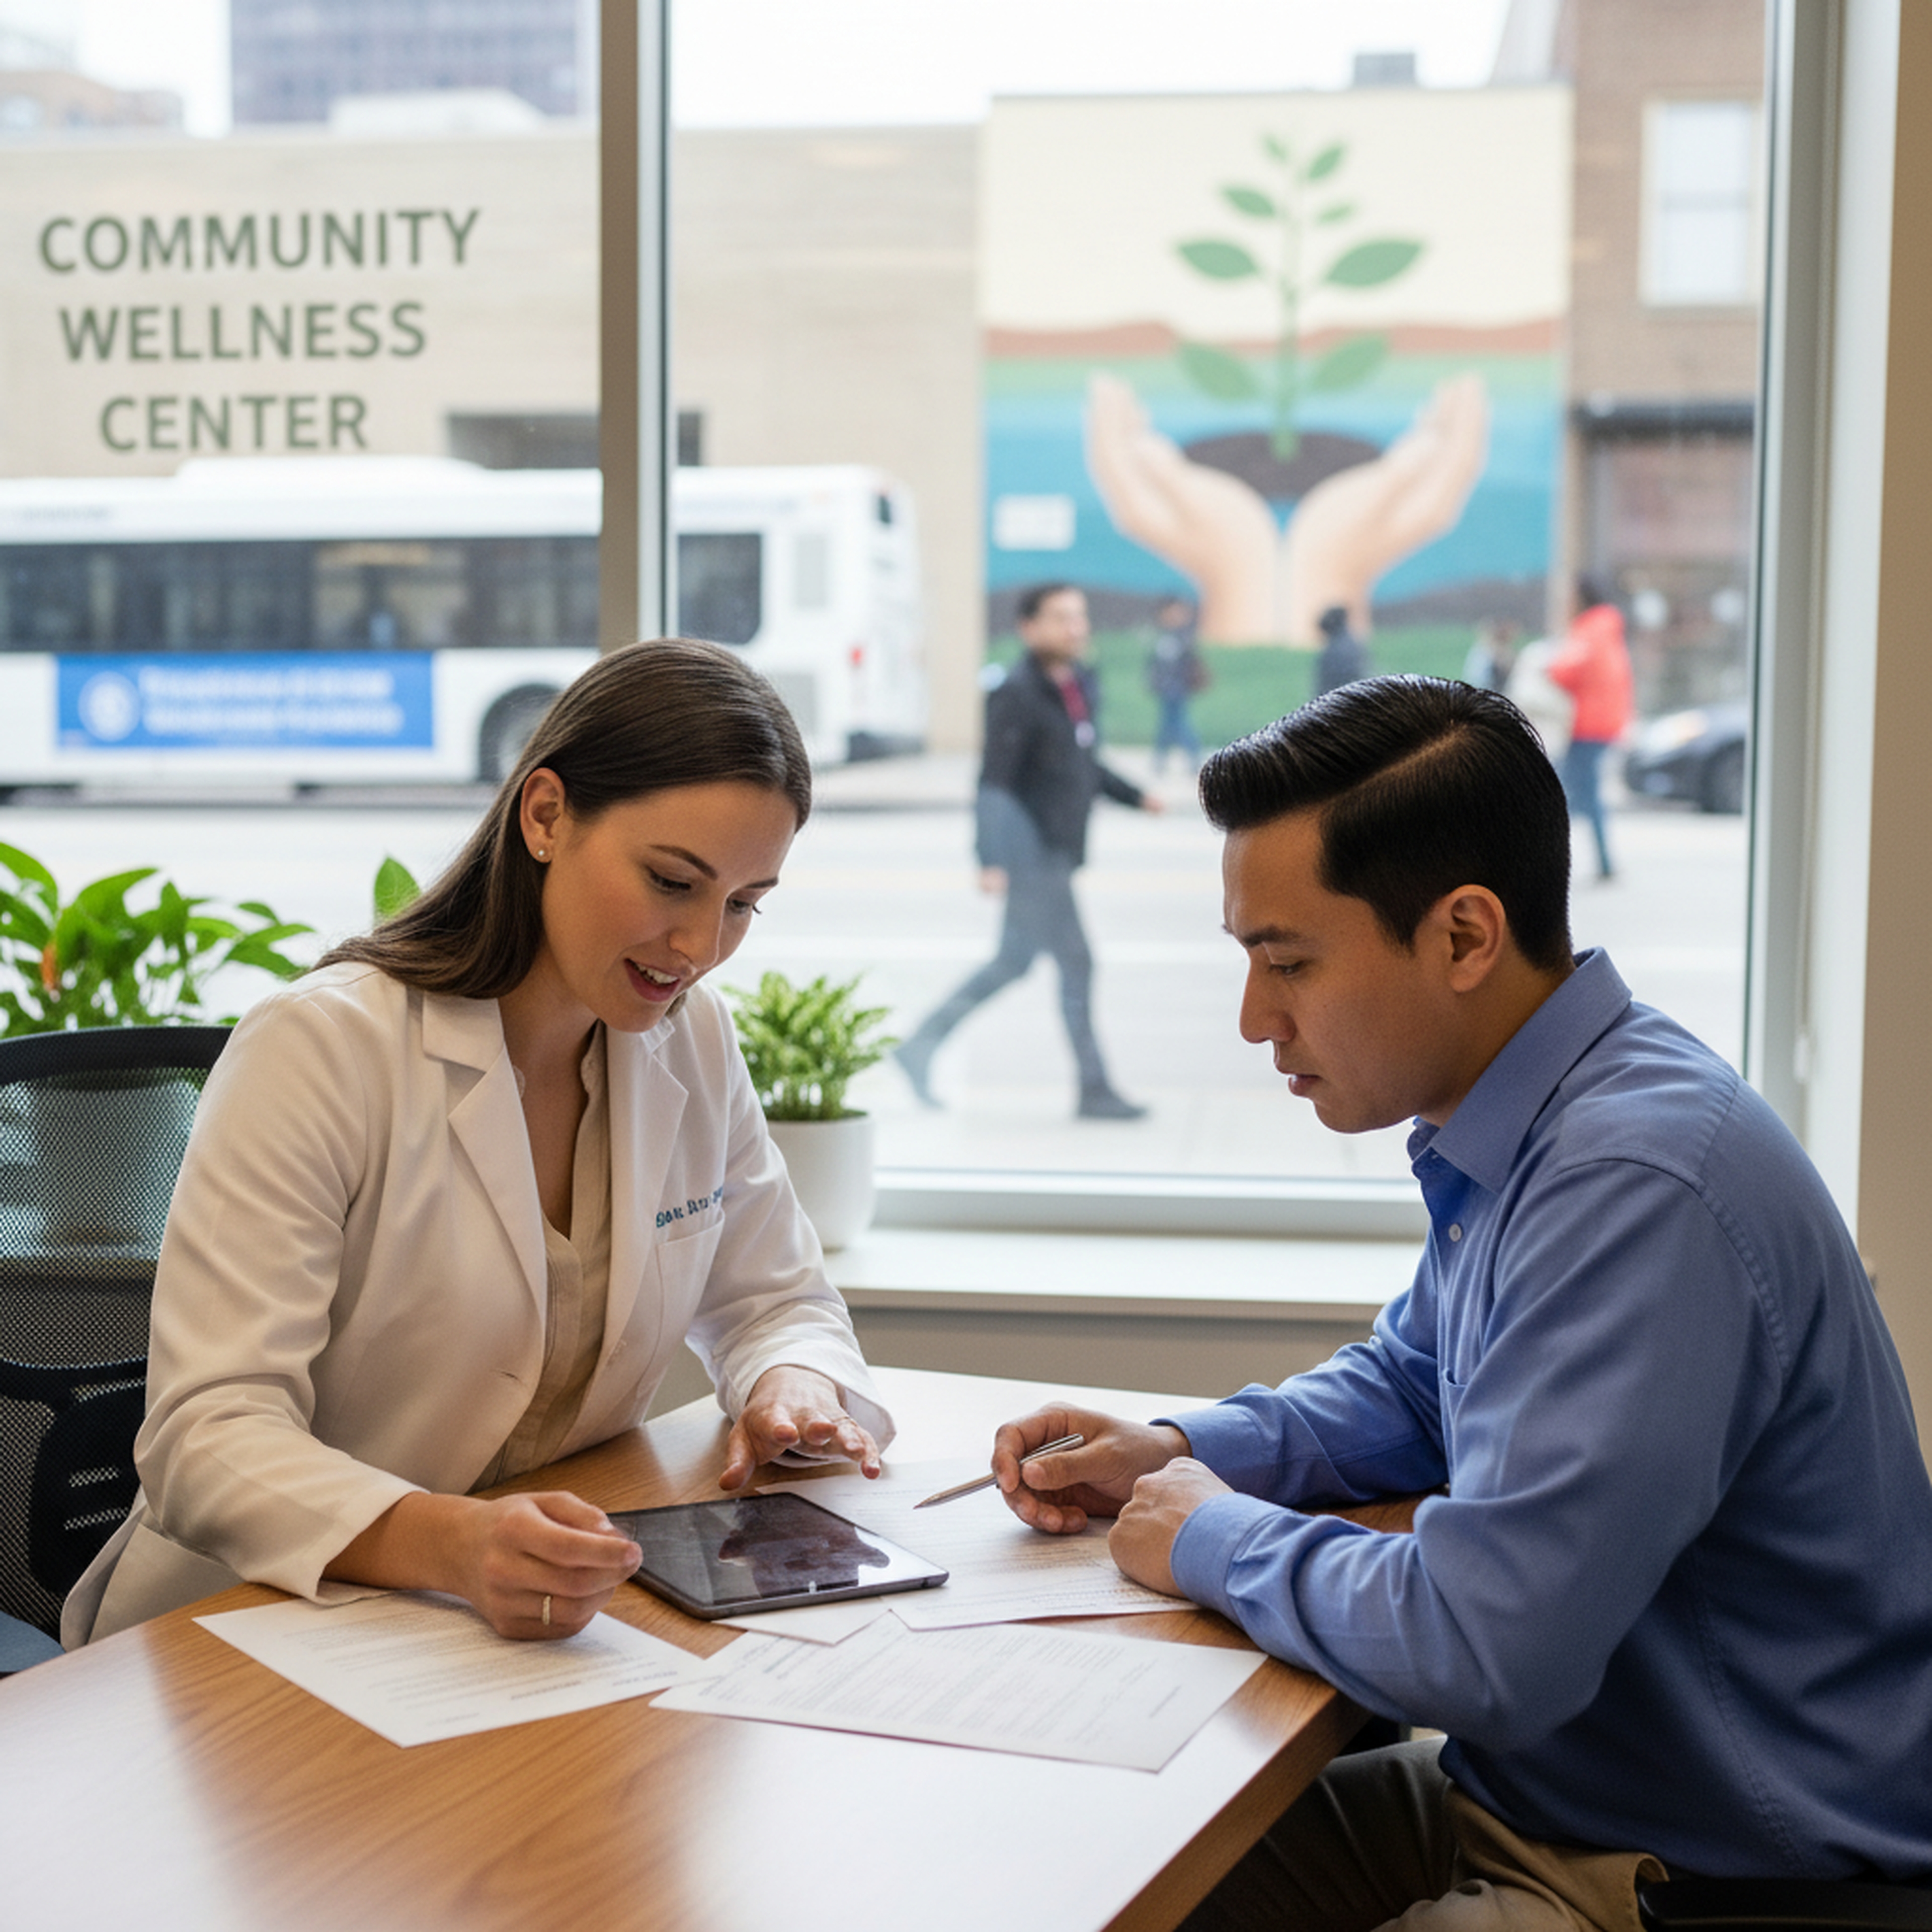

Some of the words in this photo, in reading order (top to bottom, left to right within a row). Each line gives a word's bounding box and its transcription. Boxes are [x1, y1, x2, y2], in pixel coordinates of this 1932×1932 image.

[38, 208, 480, 274] COMMUNITY
[58, 301, 426, 361] WELLNESS
[99, 394, 367, 451] CENTER
